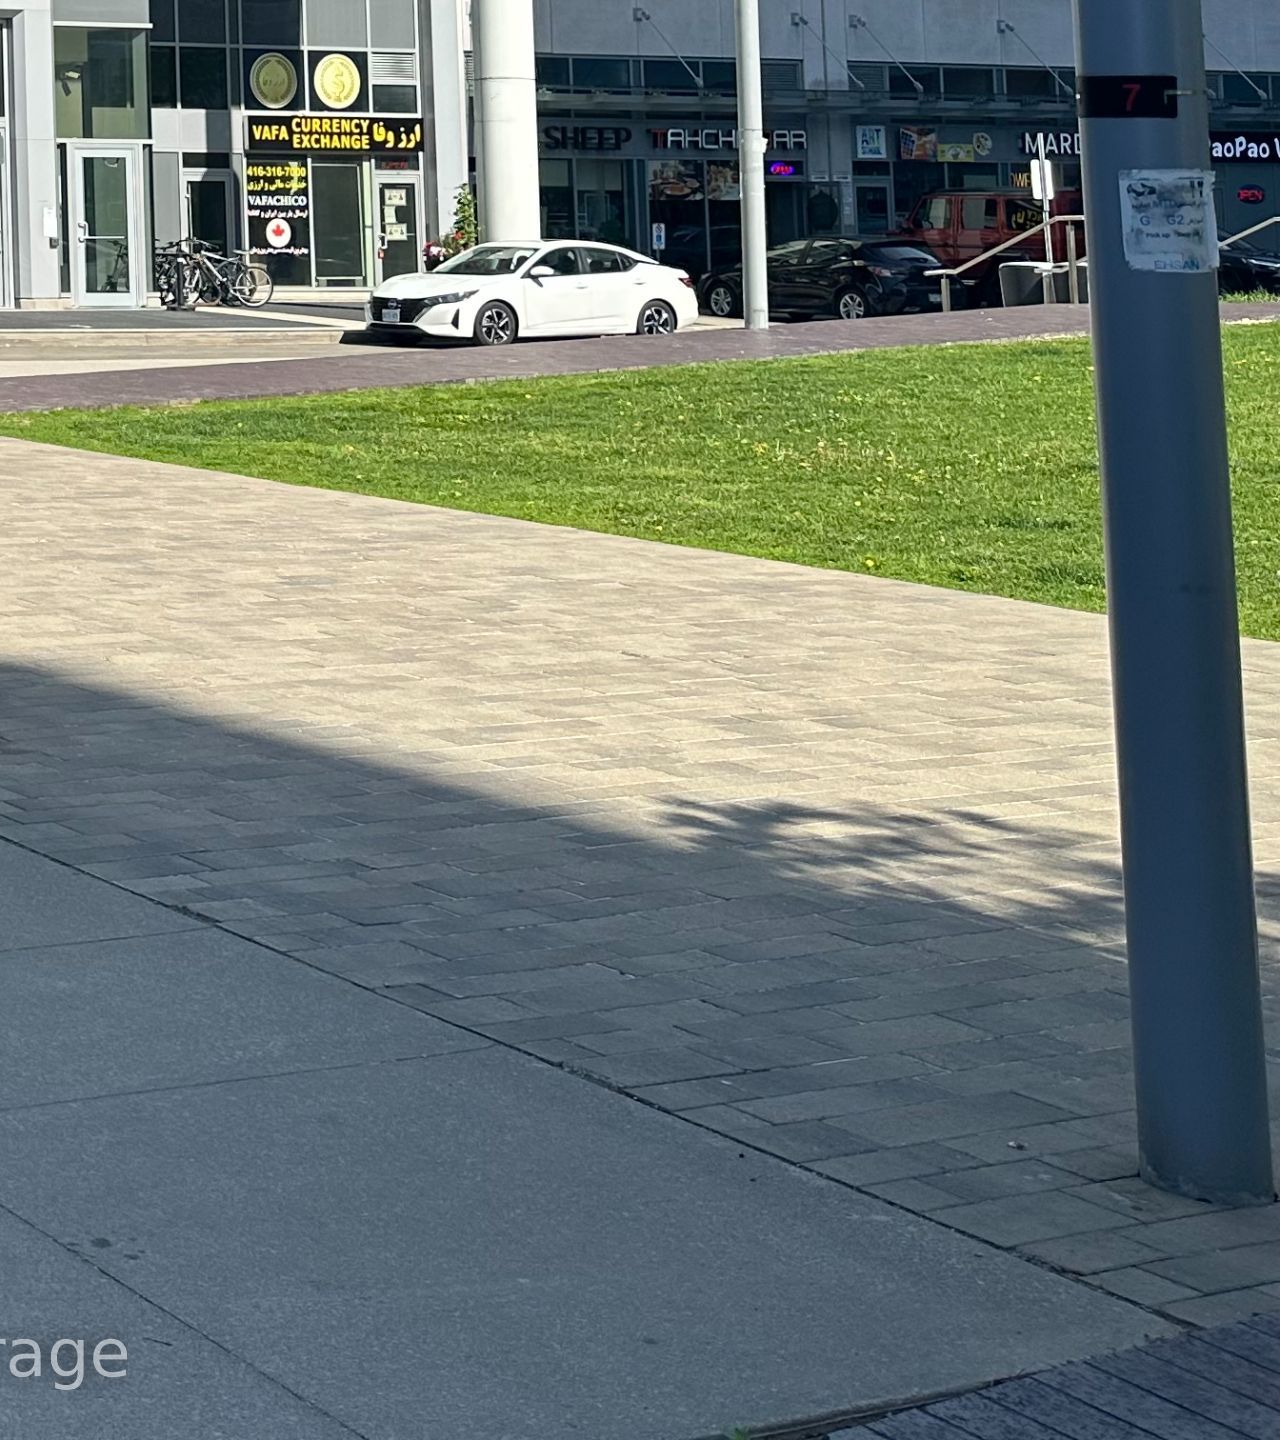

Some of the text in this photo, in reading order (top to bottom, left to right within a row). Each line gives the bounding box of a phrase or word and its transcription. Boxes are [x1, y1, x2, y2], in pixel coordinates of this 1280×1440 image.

[1122, 83, 1140, 112] 7
[252, 125, 289, 141] VAFA
[291, 117, 371, 134] CURRENCY
[291, 133, 371, 149] EXCHANGE
[544, 125, 633, 150] SHEEP
[861, 128, 882, 146] ART
[1208, 136, 1271, 158] aoPao
